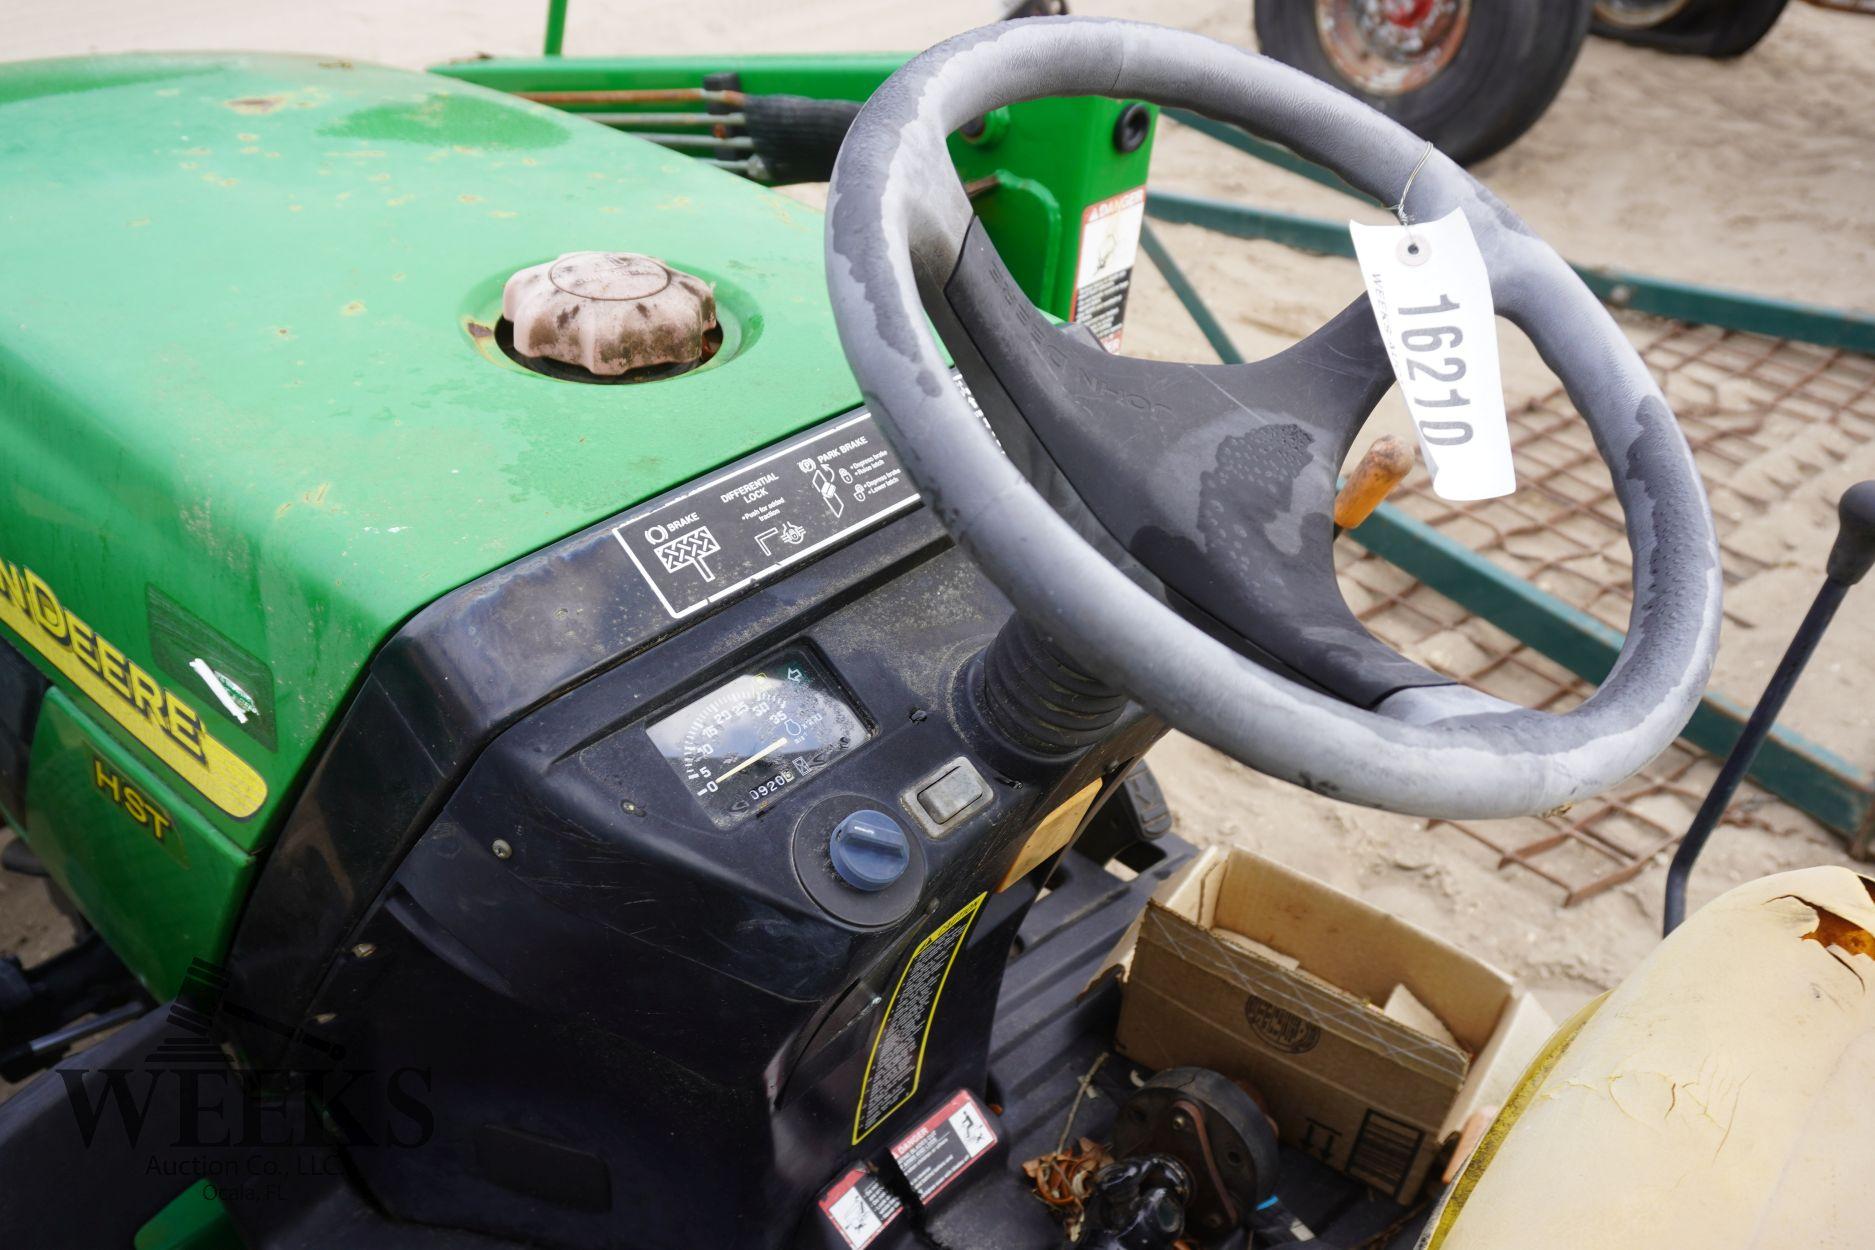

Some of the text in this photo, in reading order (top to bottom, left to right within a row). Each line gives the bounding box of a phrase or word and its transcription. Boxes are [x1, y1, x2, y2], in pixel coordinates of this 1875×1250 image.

[1398, 293, 1474, 446] 16210
[817, 435, 868, 464] PARK BRAKE
[853, 450, 888, 469] Depress brake
[720, 472, 780, 503] DIFFERENTIAL
[866, 468, 902, 488] Depress brake
[743, 487, 769, 504] LOCK
[870, 483, 887, 494] Lower
[744, 496, 785, 520] Push for added
[758, 508, 781, 522] traction
[667, 511, 700, 533] BRAKE
[23, 565, 208, 768] DEERE
[713, 709, 731, 724] 20
[769, 710, 787, 724] 35
[696, 743, 714, 755] 10
[700, 767, 712, 779] 5
[706, 780, 719, 793] 0
[93, 758, 172, 841] HST
